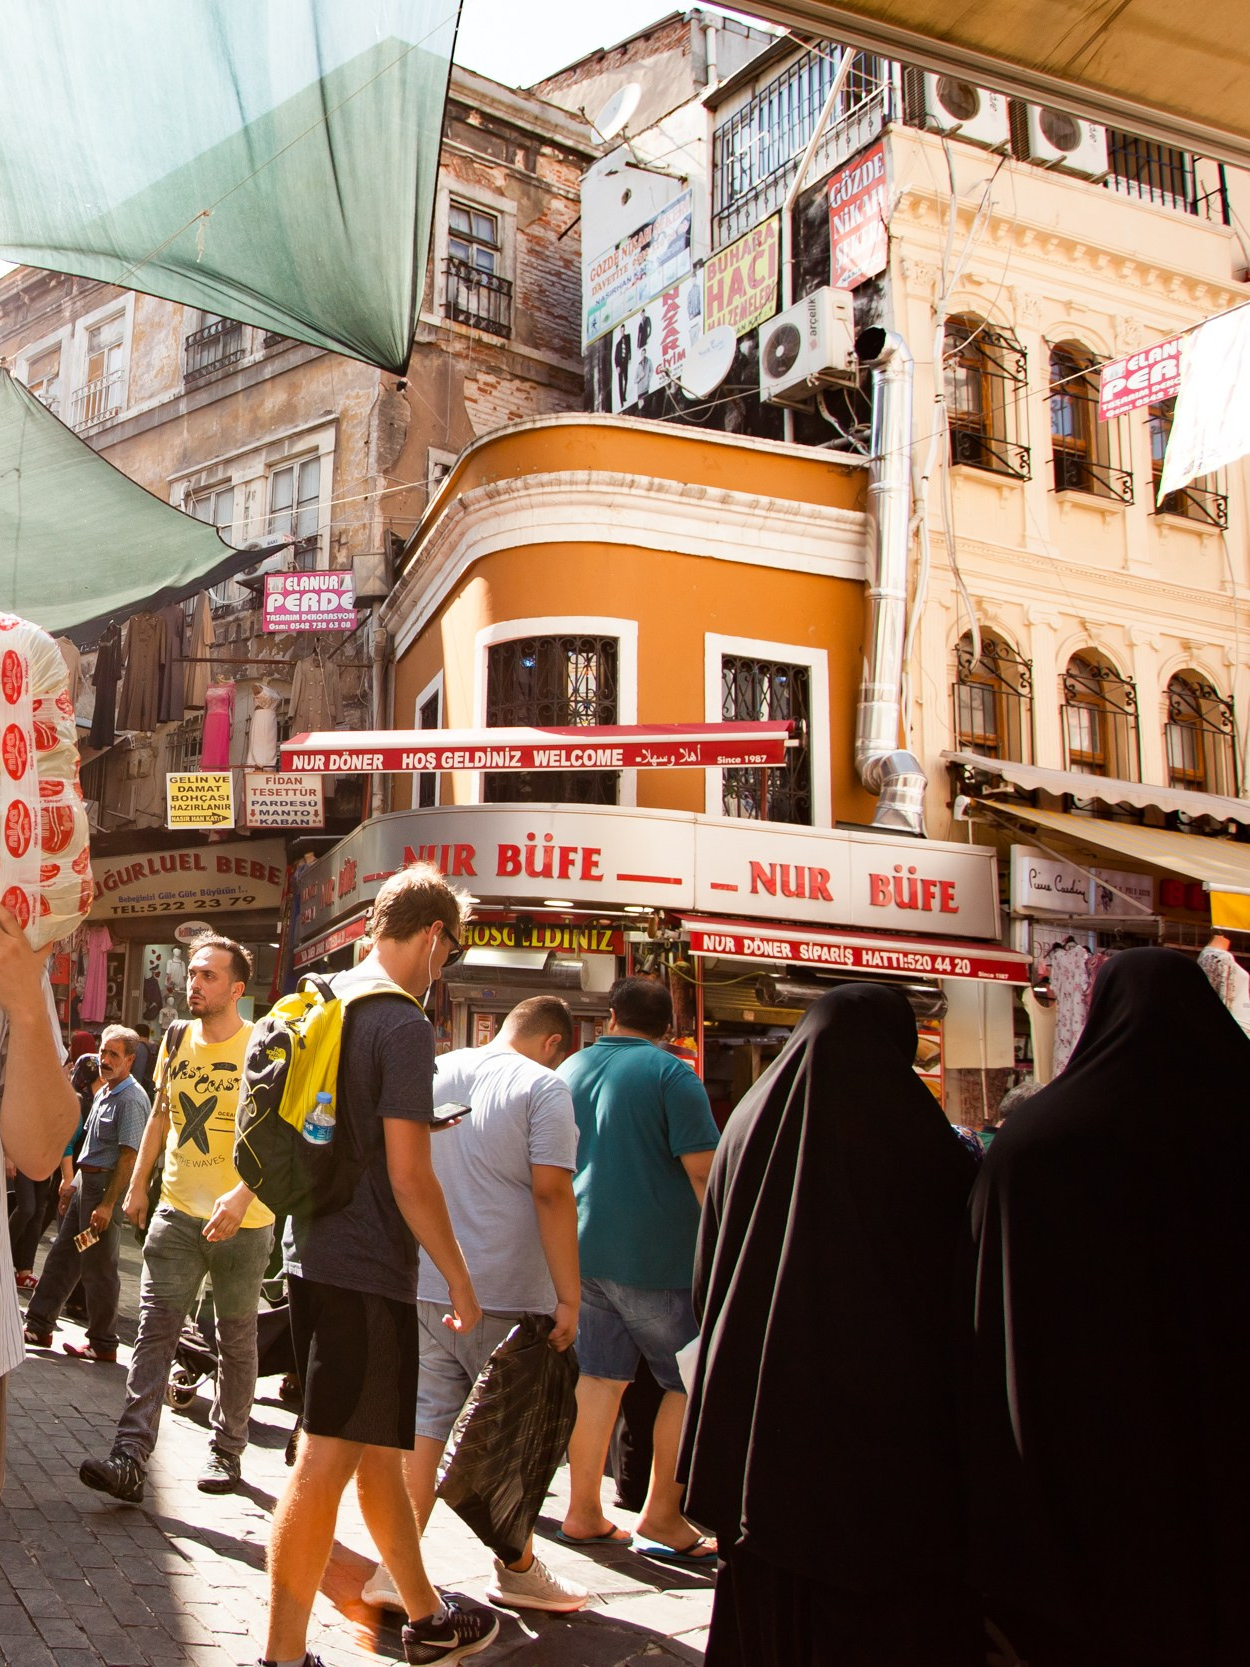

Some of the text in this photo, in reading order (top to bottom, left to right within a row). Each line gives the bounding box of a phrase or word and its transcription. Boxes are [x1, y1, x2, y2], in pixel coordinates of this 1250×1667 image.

[830, 152, 884, 209] GÖZDE
[707, 222, 775, 282] BUHARA
[707, 241, 776, 319] HACI
[285, 576, 339, 591] ELANUR
[266, 592, 353, 613] PERDE
[266, 612, 355, 622] TASARIM DEKORASYON
[290, 622, 310, 630] 0542
[312, 621, 327, 629] 738
[329, 621, 339, 629] 63
[292, 748, 623, 770] NUR DÖNER HOŞ GELDİNİZ WELCOME
[717, 755, 767, 764] Since 1987
[169, 776, 210, 784] GELİN
[265, 774, 303, 785] FİDAN
[177, 785, 222, 793] DAMAT
[251, 786, 317, 797] TESETTÜR
[171, 794, 229, 803] BOHÇASI
[251, 799, 318, 808] PARDESÜ
[170, 803, 231, 811] HAZIRLANIR
[258, 809, 311, 817] MANTO
[259, 818, 310, 826] KABAN
[403, 832, 604, 881] NUR BÜFE
[216, 855, 283, 887] BEBE
[749, 860, 960, 914] NUR BÜFE
[158, 890, 176, 901] Güle
[178, 889, 197, 899] Güle
[200, 887, 236, 898] Büyütün
[193, 899, 222, 909] 23
[228, 895, 257, 906] 79
[703, 934, 971, 974] NUR DÖNER SİPARİŞ HATTI:520 44 20
[978, 971, 995, 979] Since
[179, 1157, 190, 1167] THE
[192, 1154, 225, 1168] WAVES
